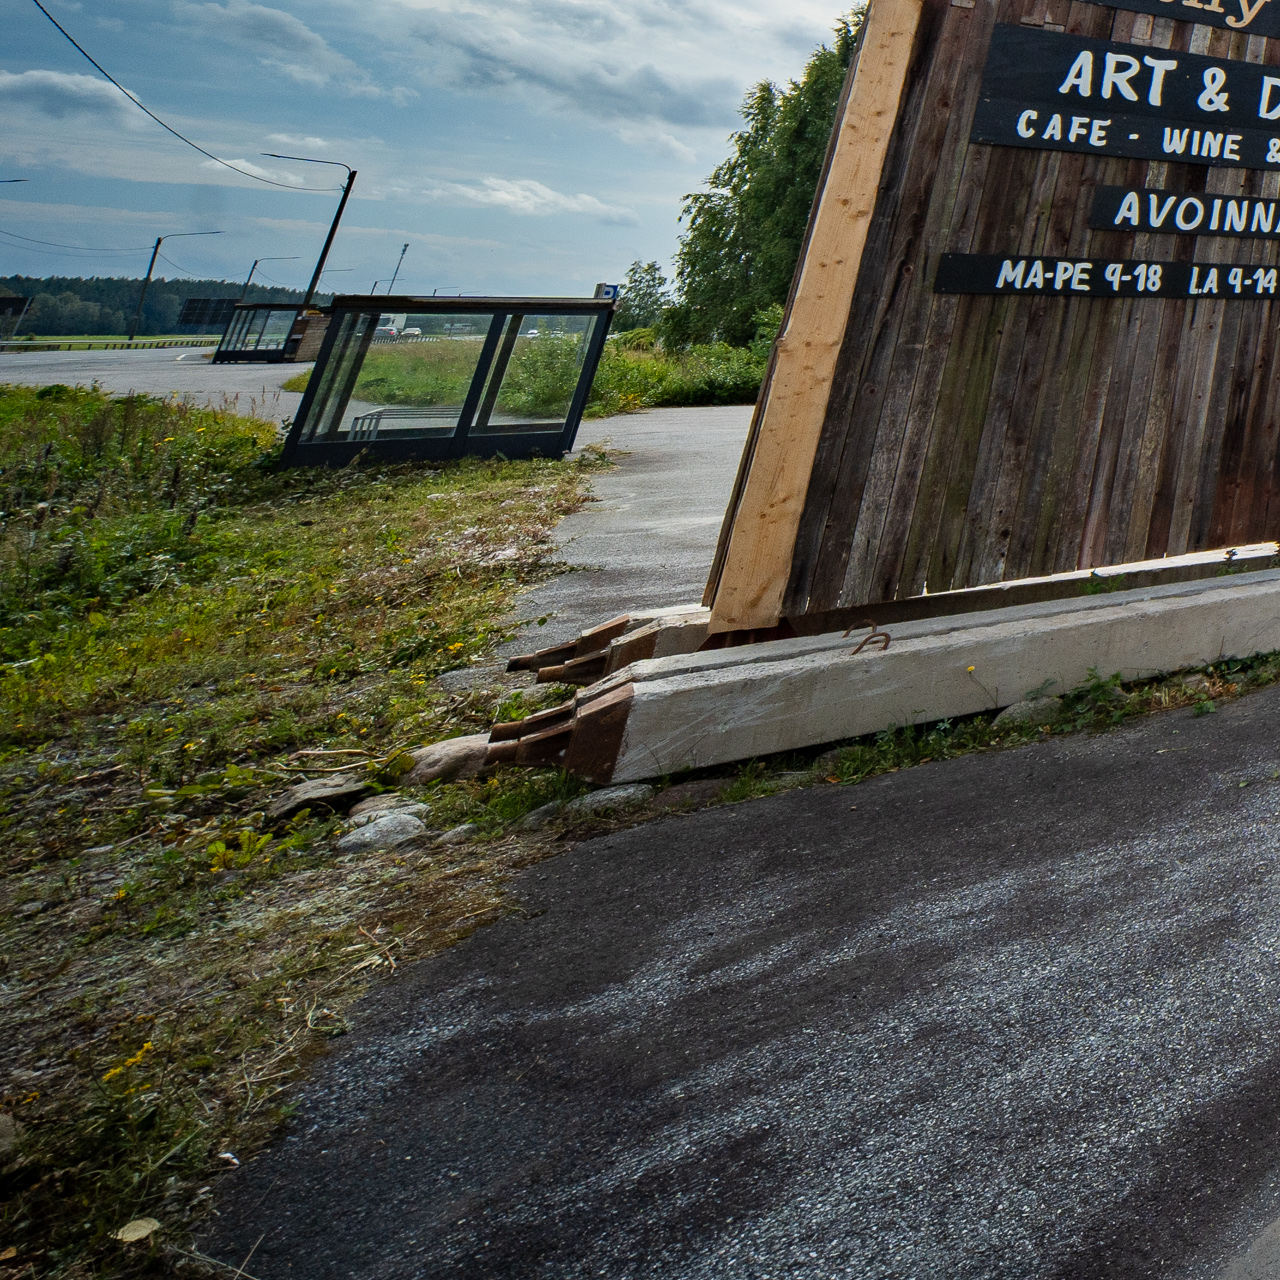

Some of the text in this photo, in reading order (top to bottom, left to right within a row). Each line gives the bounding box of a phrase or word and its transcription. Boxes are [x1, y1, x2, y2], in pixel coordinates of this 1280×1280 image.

[1059, 51, 1178, 106] ART
[1198, 67, 1230, 112] &
[1016, 109, 1111, 147] CAFE
[1163, 127, 1242, 161] WINE
[996, 259, 1093, 291] MA-PE
[1105, 264, 1163, 292] 9-18
[1188, 267, 1219, 294] LA
[1228, 269, 1278, 294] 9-14
